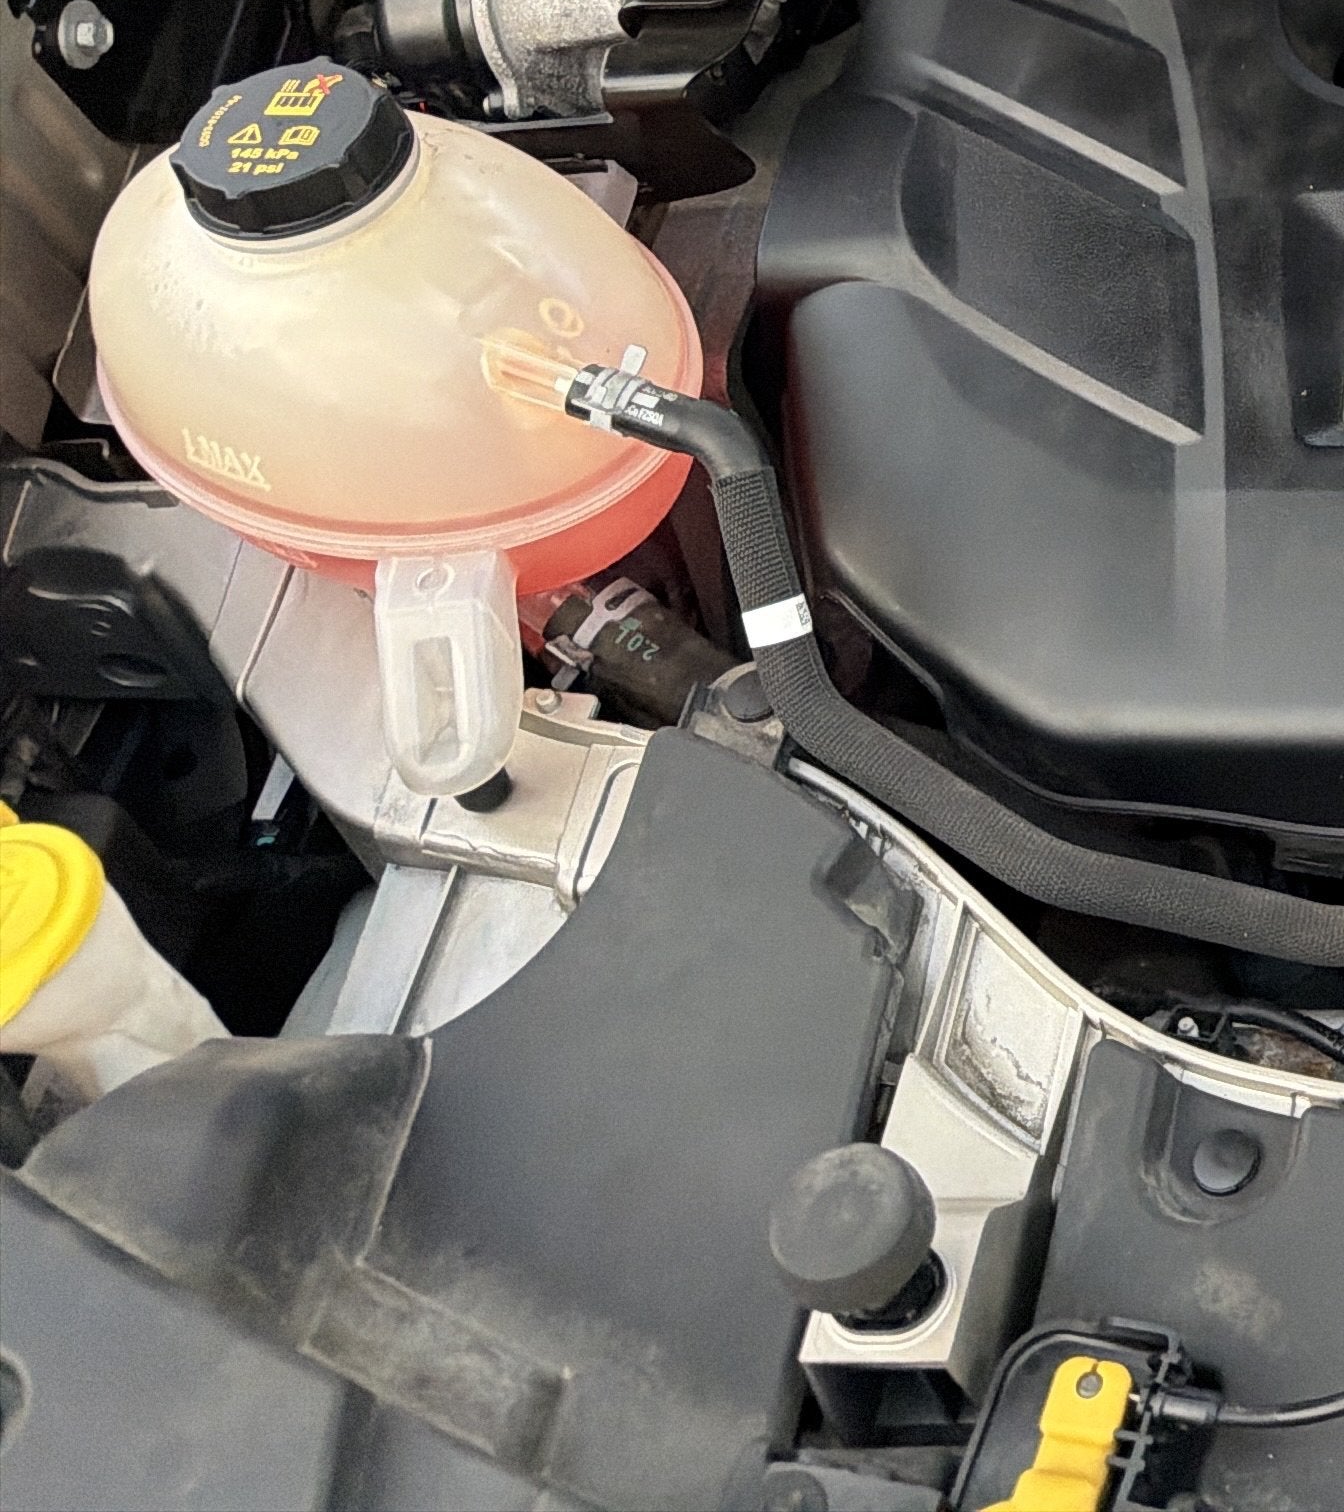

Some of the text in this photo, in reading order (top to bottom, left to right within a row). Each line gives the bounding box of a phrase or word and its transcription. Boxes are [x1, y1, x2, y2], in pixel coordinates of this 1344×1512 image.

[231, 147, 300, 160] 145 kPa
[228, 162, 285, 176] 21 psi
[615, 622, 661, 663] 2.0L
